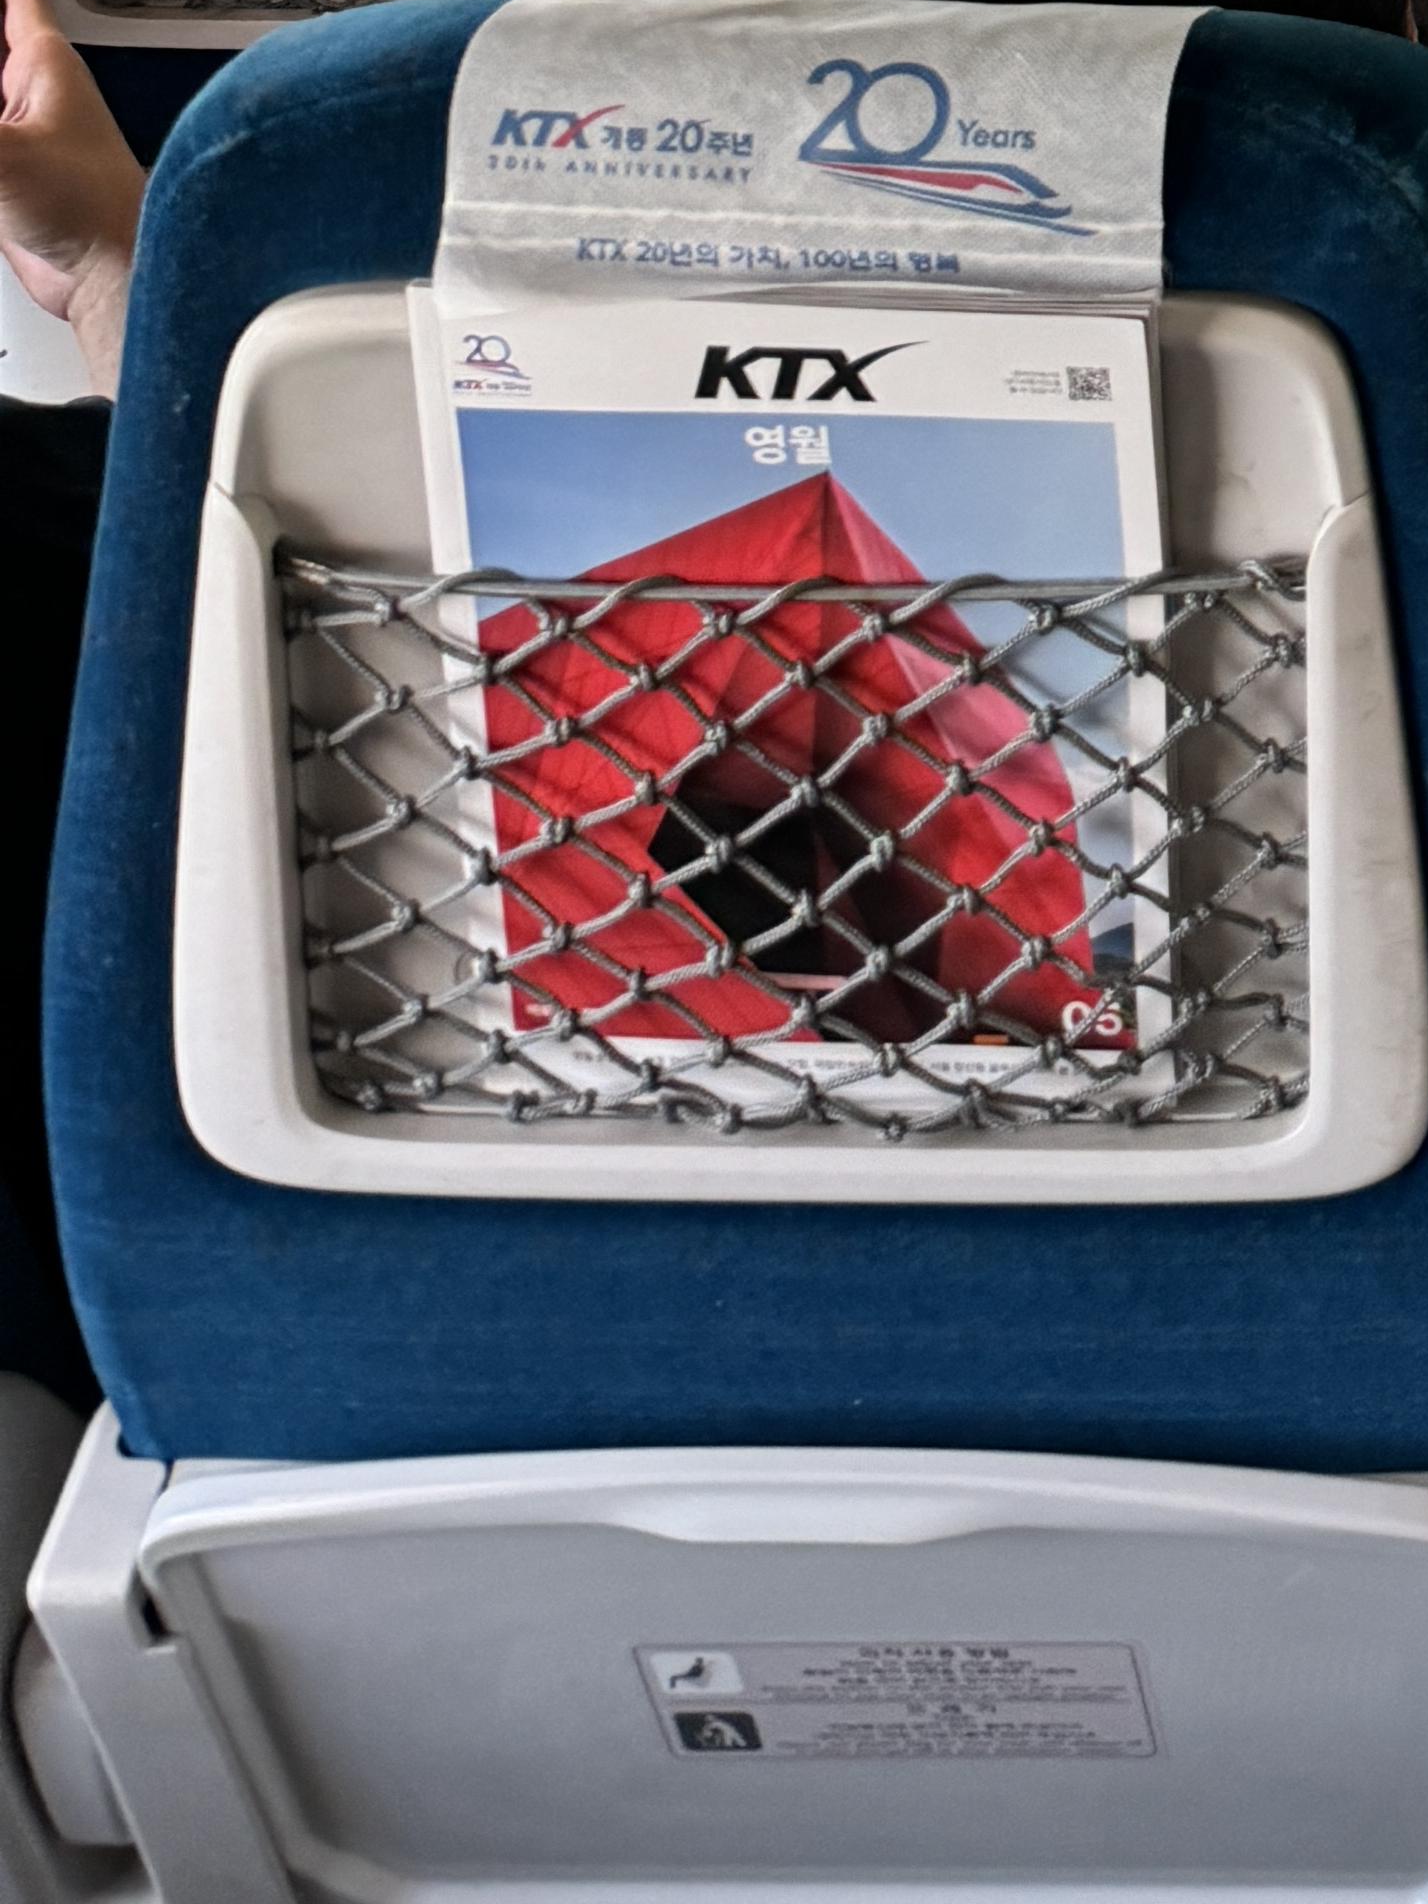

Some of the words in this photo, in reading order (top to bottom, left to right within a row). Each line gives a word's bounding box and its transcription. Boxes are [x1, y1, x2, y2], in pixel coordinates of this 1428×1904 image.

[491, 104, 625, 151] KTX
[656, 117, 754, 159] 20주년
[798, 58, 951, 165] 20
[956, 118, 1037, 153] Years
[577, 239, 625, 263] KTX
[635, 239, 720, 270] 20년의
[729, 243, 791, 273] 가치,
[798, 245, 898, 274] 100년의
[693, 340, 931, 403] KTX
[743, 423, 834, 466] 영월
